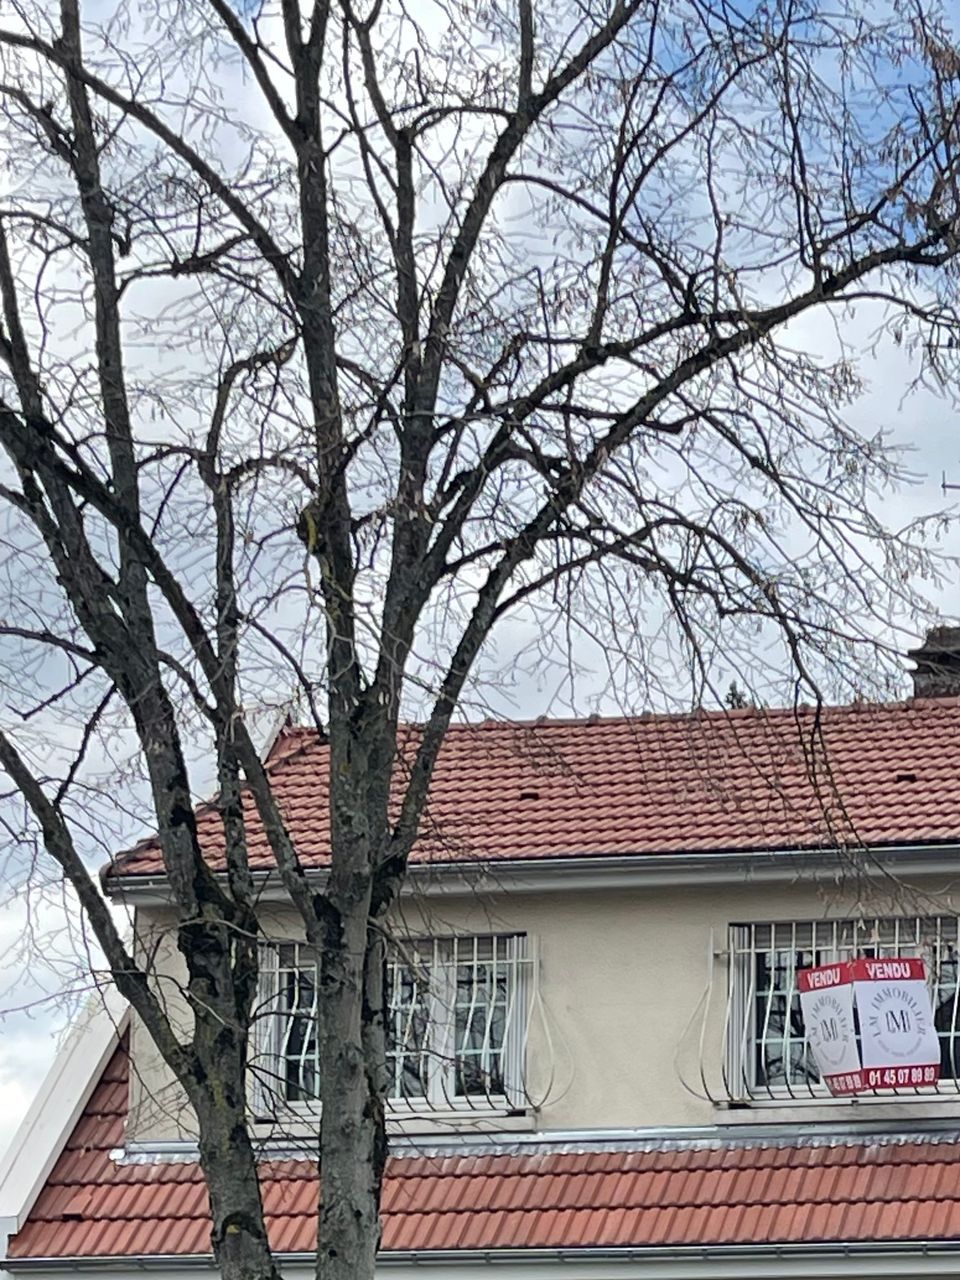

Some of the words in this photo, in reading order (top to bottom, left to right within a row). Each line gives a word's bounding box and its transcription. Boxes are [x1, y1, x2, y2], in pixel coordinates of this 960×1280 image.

[807, 967, 841, 989] VENDU
[865, 962, 911, 978] VENDU
[869, 1070, 881, 1086] 01
[884, 1069, 896, 1085] 45
[898, 1069, 909, 1084] 07
